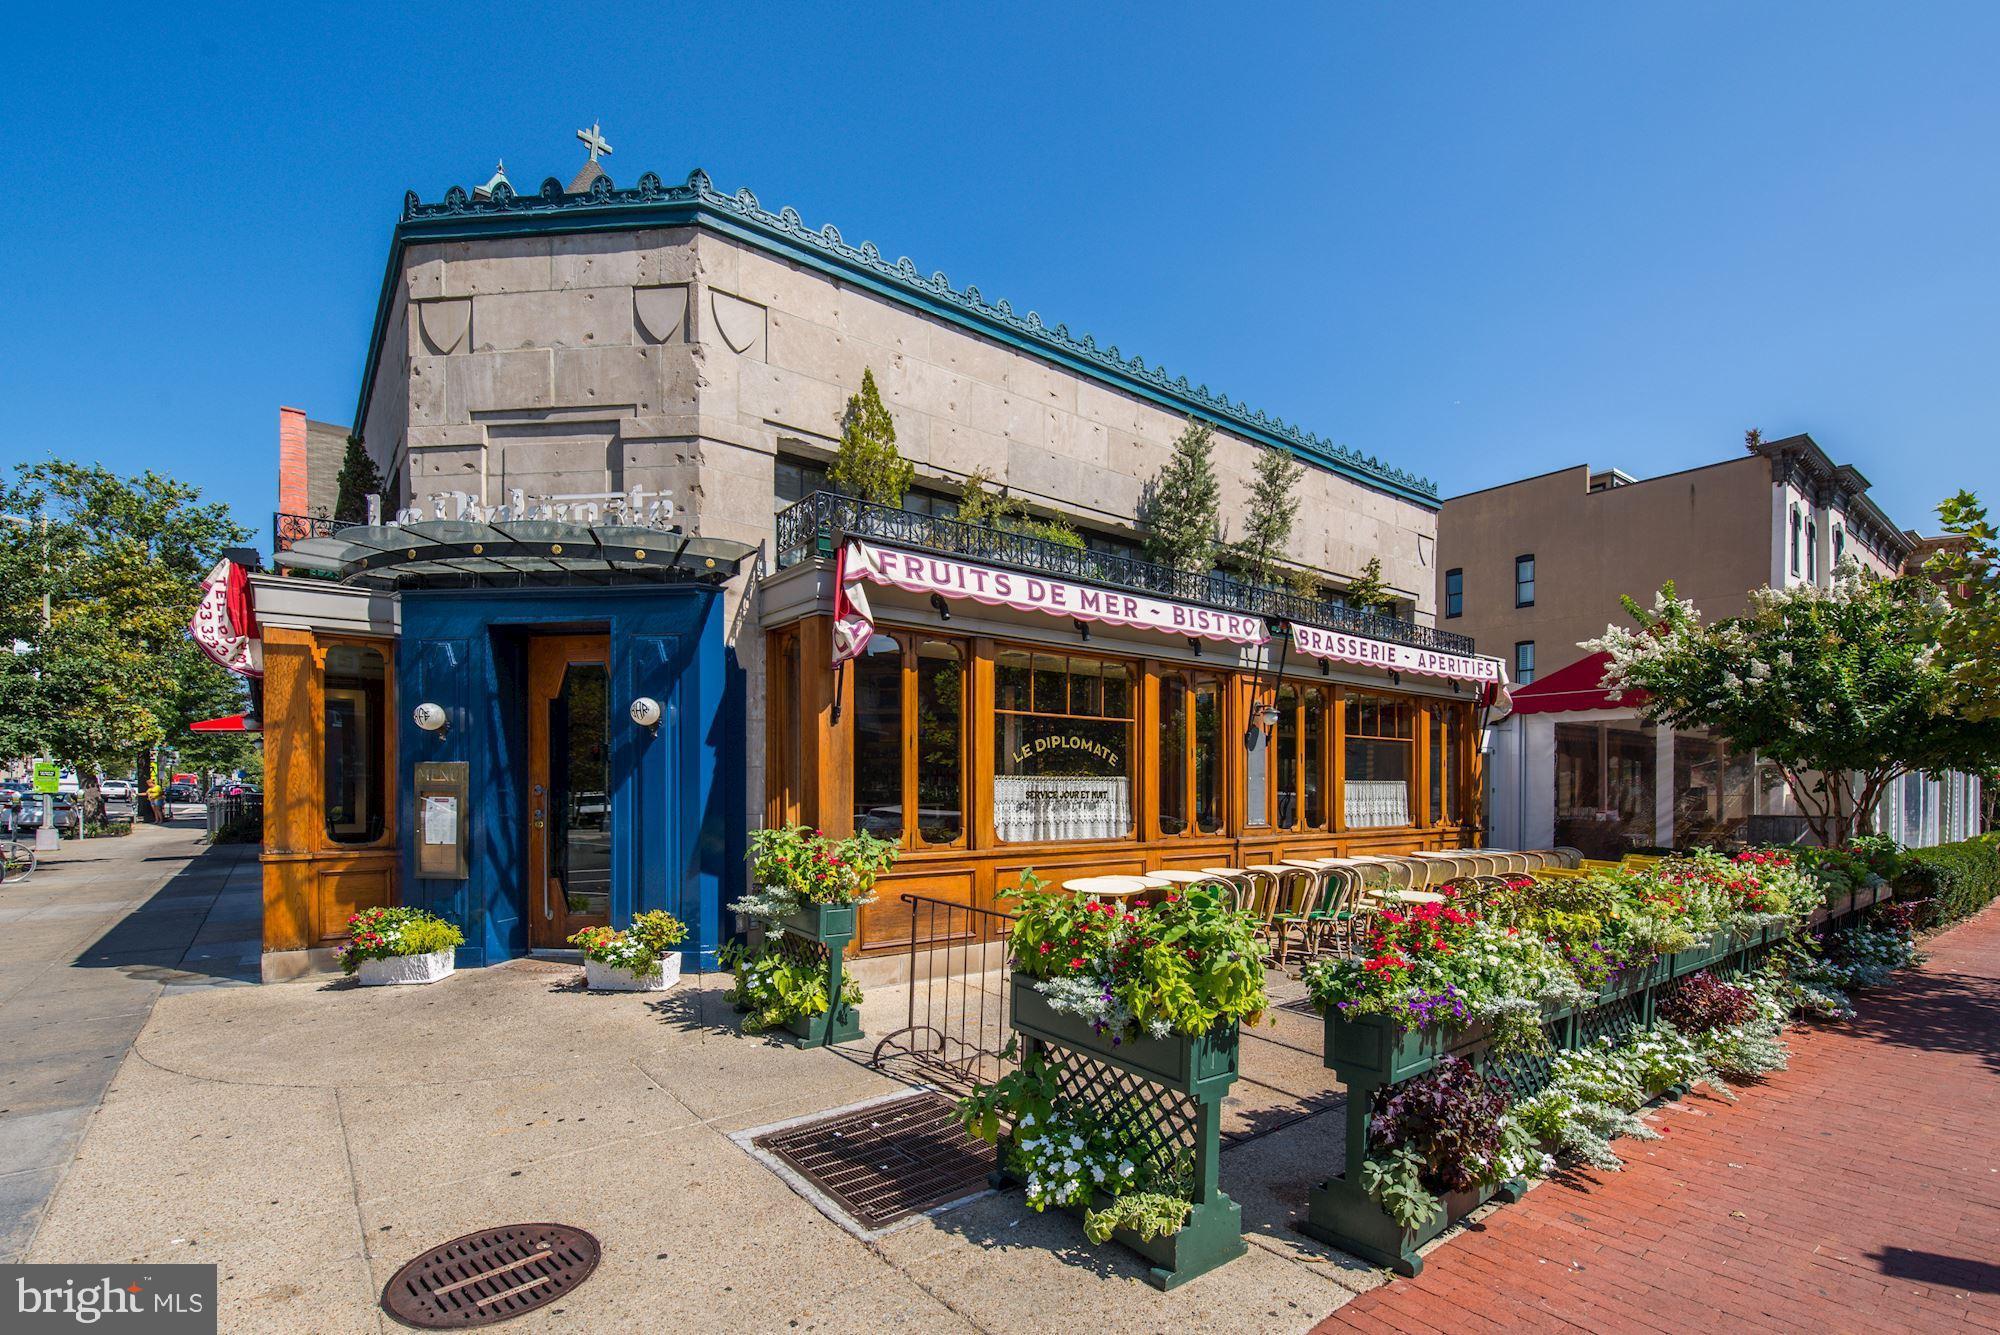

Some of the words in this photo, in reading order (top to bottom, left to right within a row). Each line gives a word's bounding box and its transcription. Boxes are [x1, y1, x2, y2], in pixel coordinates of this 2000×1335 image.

[878, 551, 1012, 597] FRUITS
[1027, 579, 1067, 607] DE
[1080, 589, 1139, 619] MER
[1171, 606, 1256, 637] BISTRO
[1299, 629, 1397, 664] BRASSERIE
[1012, 743, 1033, 763] LE
[1034, 735, 1119, 767] DIPLOMATE
[1025, 790, 1058, 800] SERVICE
[1060, 790, 1079, 800] JOUR
[1081, 790, 1090, 800] ET
[1091, 790, 1107, 800] NUIT
